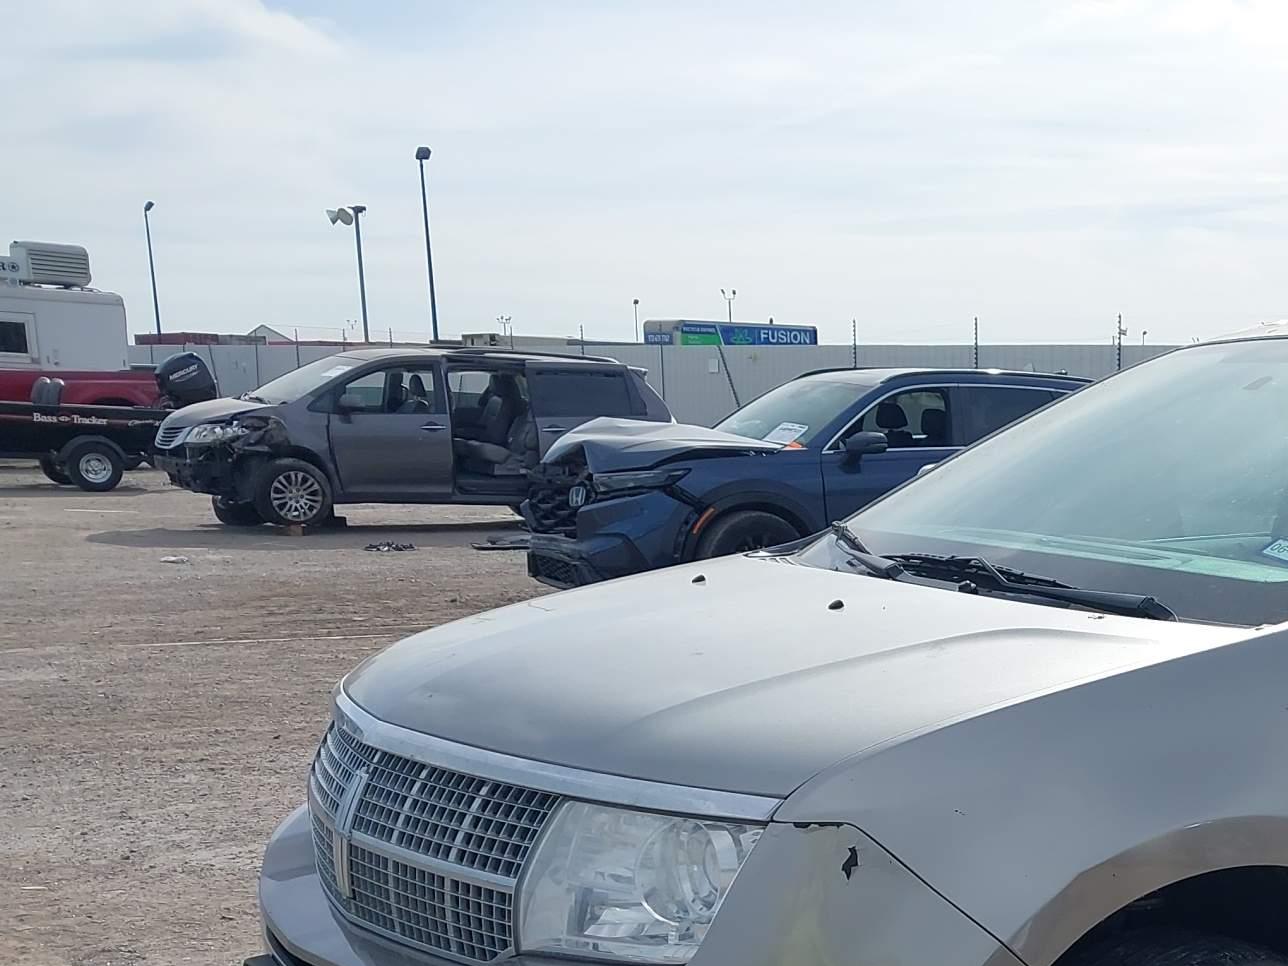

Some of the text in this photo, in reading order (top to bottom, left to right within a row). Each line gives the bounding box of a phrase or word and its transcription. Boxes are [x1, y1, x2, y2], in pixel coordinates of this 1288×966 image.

[760, 329, 810, 344] FUSION
[33, 412, 109, 425] Bass Tracker
